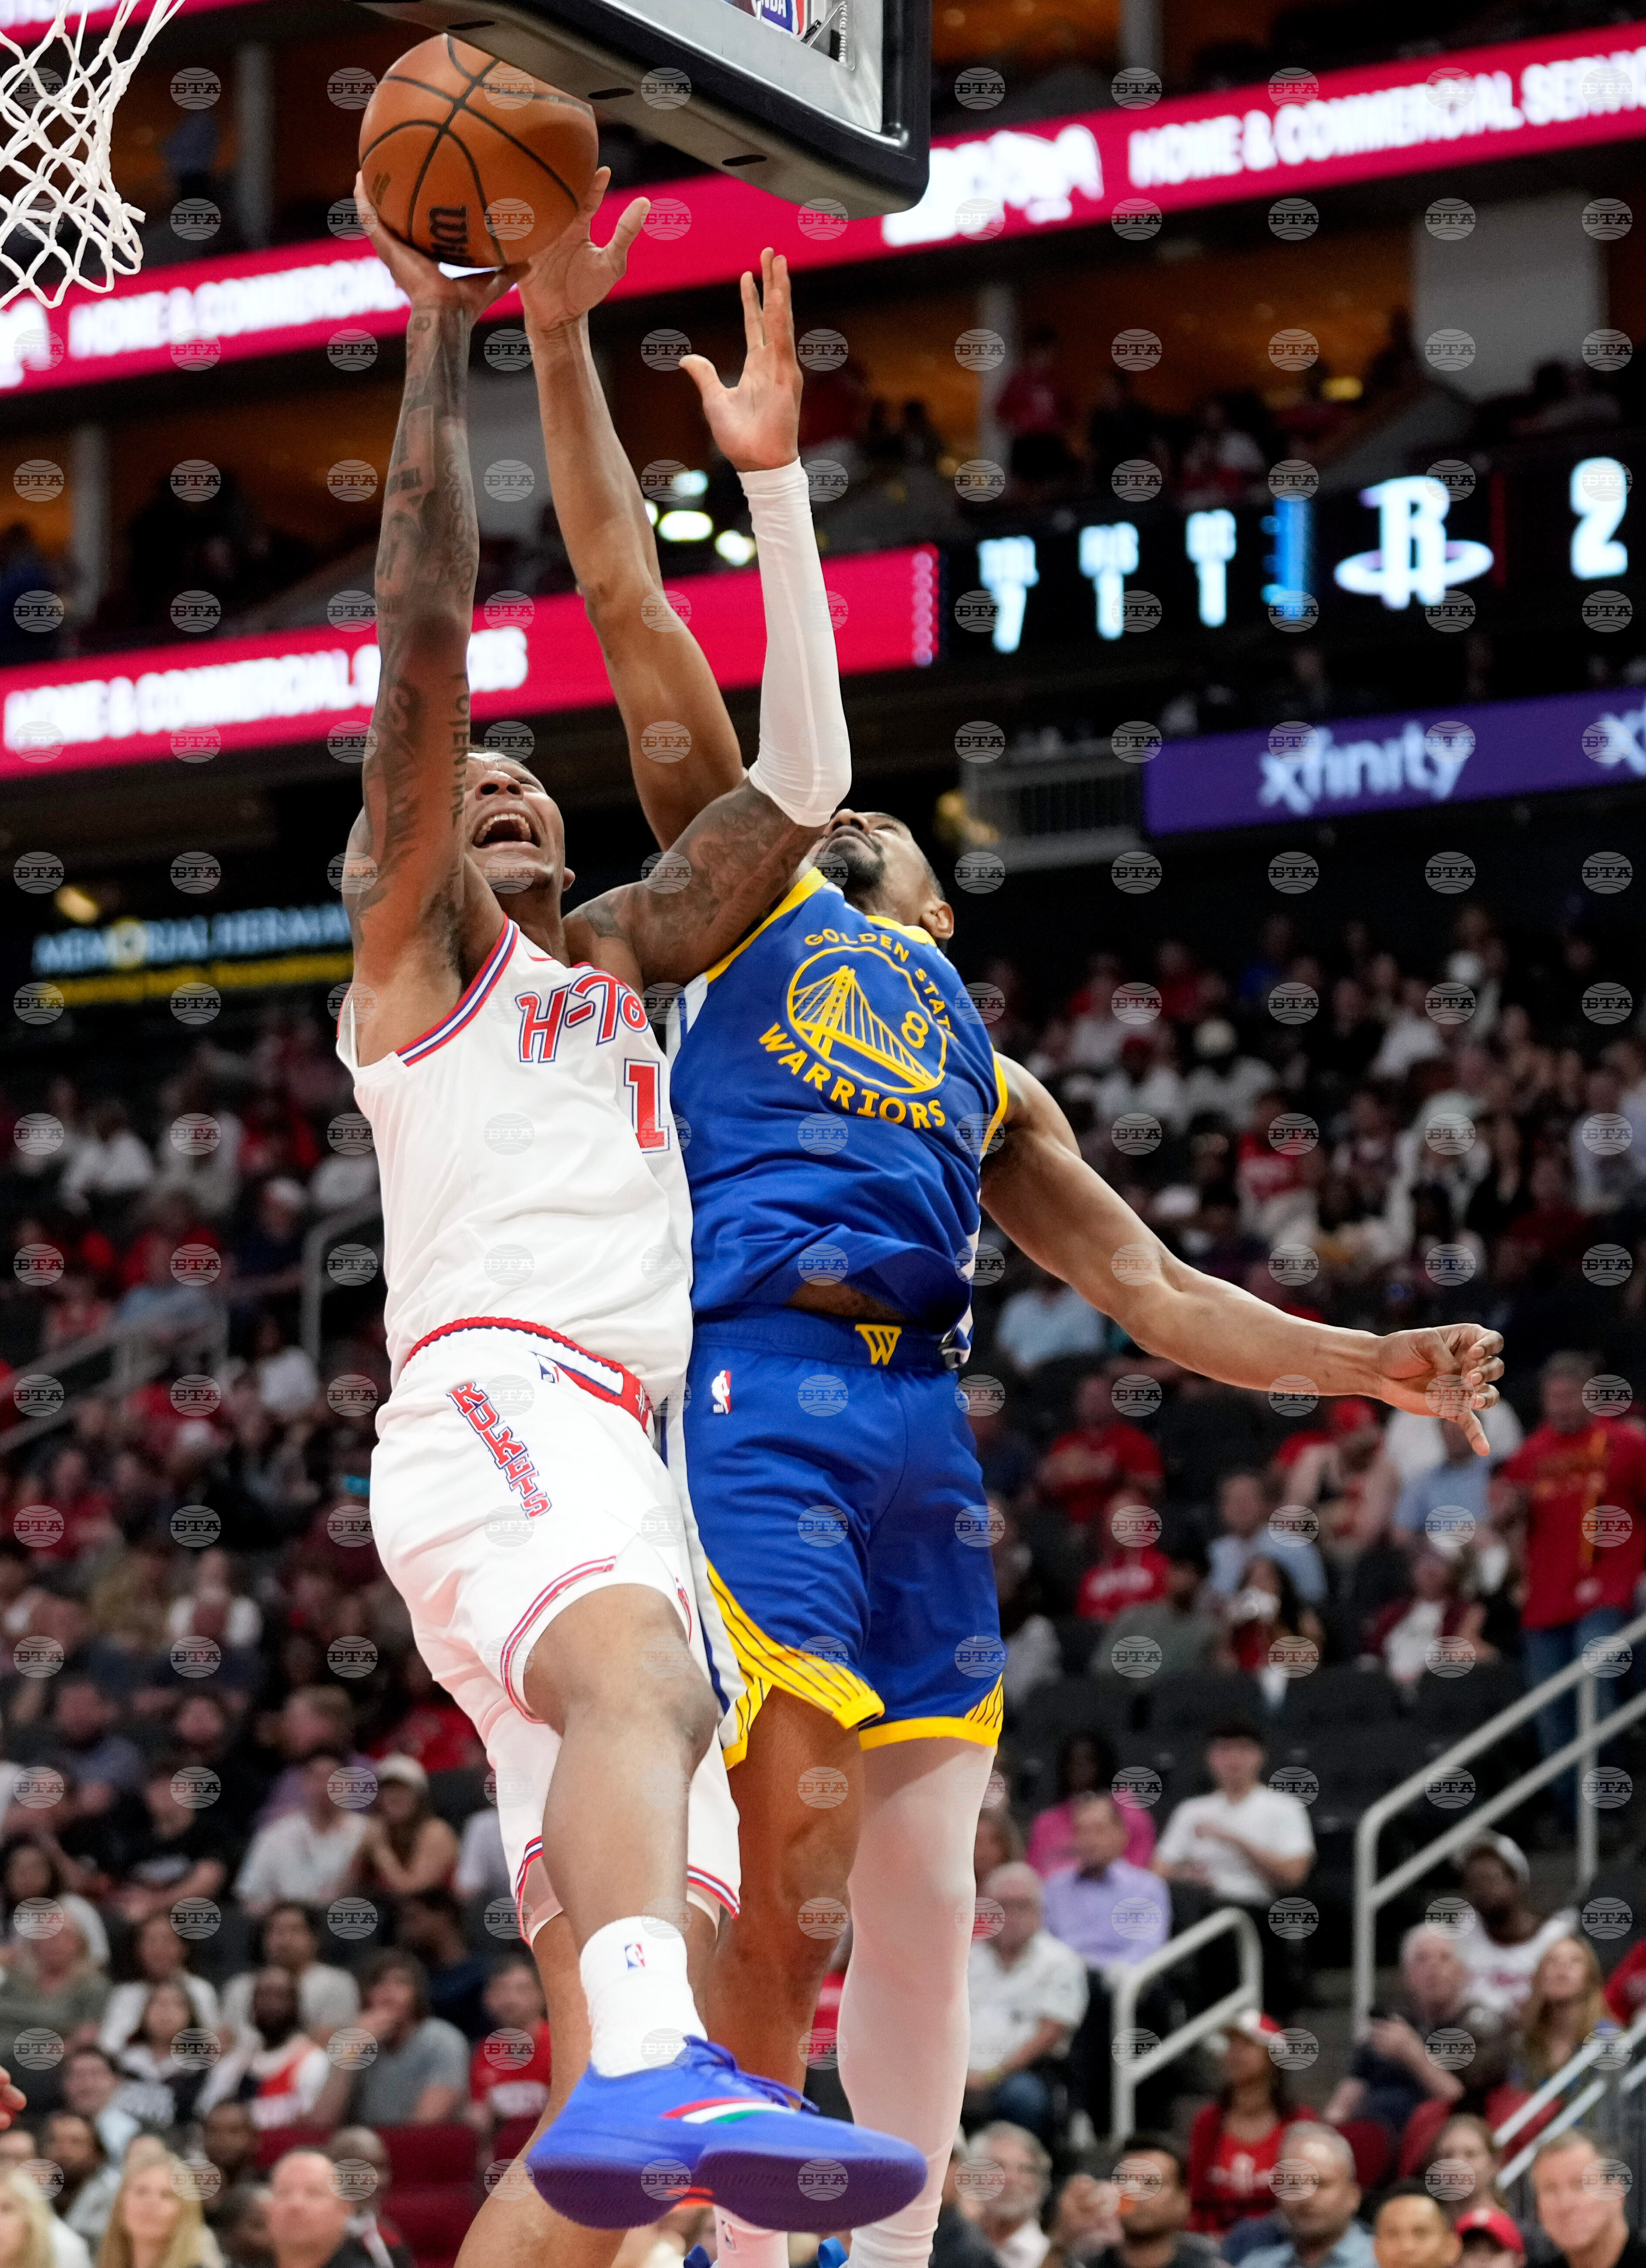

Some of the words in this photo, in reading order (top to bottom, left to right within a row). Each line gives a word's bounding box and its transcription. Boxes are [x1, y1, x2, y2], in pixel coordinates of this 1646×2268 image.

[1258, 720, 1468, 815] xfinity
[804, 928, 910, 963] GOLDEN
[914, 968, 959, 1042] STAT
[901, 1011, 929, 1049] 8
[758, 1022, 947, 1129] WARRIORS
